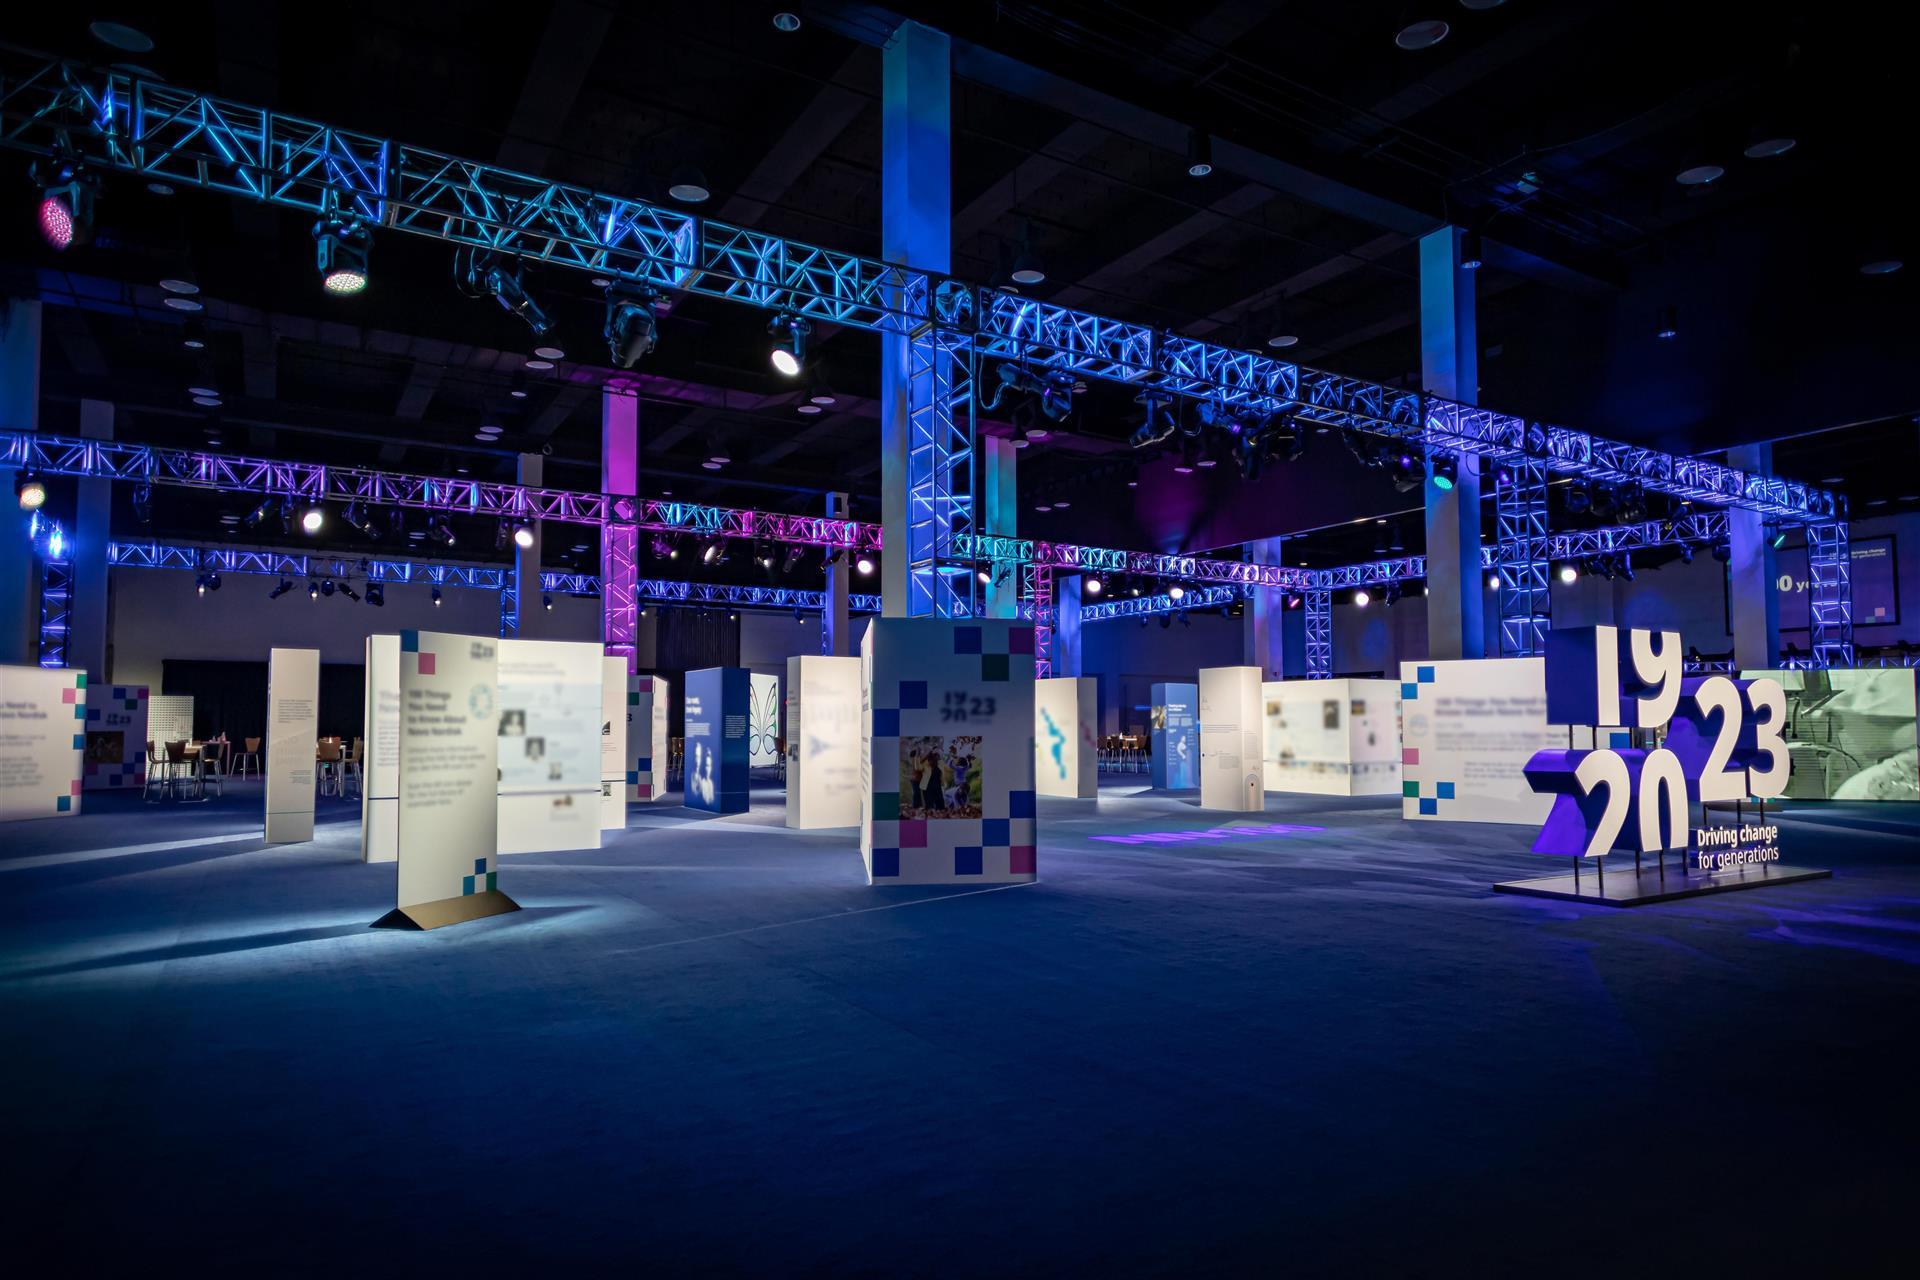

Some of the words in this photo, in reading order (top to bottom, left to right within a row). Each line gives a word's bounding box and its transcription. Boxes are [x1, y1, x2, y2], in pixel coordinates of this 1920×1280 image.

[1776, 575, 1793, 592] 0
[1596, 625, 1682, 727] 19
[1695, 676, 1790, 802] 23
[1575, 749, 1689, 857] 20
[1697, 826, 1738, 848] Driving
[1740, 824, 1778, 844] change
[1698, 851, 1714, 869] for
[1717, 845, 1779, 872] generations
